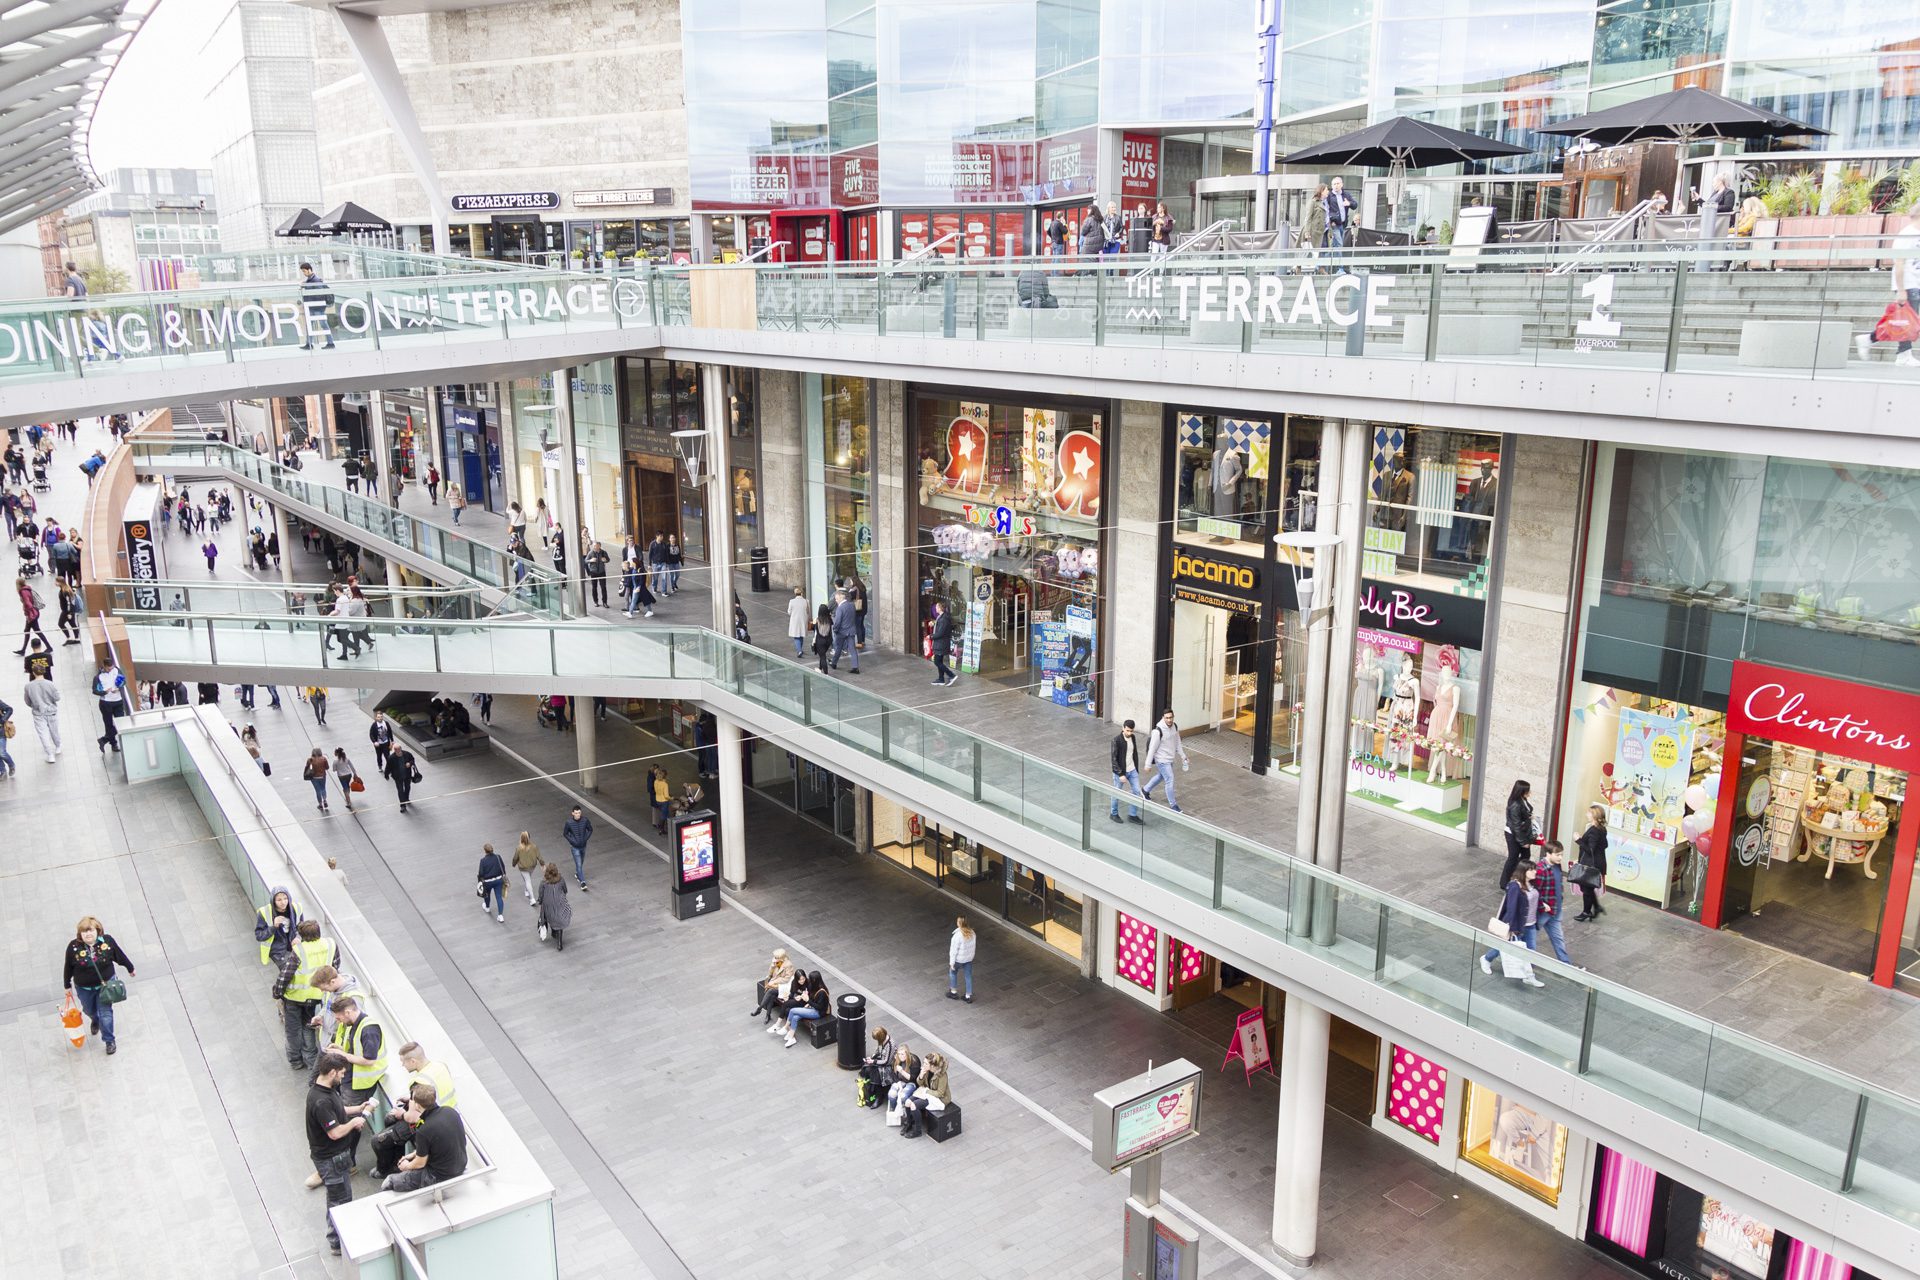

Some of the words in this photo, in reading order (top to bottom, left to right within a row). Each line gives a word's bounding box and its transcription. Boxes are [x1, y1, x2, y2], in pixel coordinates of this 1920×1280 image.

[1123, 141, 1153, 160] FIVE
[845, 158, 861, 176] FIVE
[1050, 154, 1080, 179] FRESH
[1120, 160, 1156, 179] GUYS
[732, 176, 787, 190] FREEZER
[844, 174, 863, 192] GUYS
[925, 174, 951, 186] NOW
[953, 174, 992, 186] HIRING
[457, 193, 550, 208] PIZZAEXPRESS
[763, 192, 789, 200] JOINT
[1125, 277, 1163, 298] THE
[1172, 274, 1396, 327] TERRACE
[0, 312, 153, 365] DINING
[164, 310, 193, 348] &
[200, 300, 331, 345] MORE
[340, 296, 402, 334] ON
[403, 294, 440, 312] THE
[447, 283, 610, 325] TERRACE
[1573, 346, 1592, 354] ONE
[1574, 338, 1618, 349] LIVERPOOL
[1382, 530, 1405, 550] DAY
[1172, 549, 1255, 590] jacamo
[1177, 590, 1249, 613] www.jacamo.co.uk
[1743, 683, 1911, 750] Clintons
